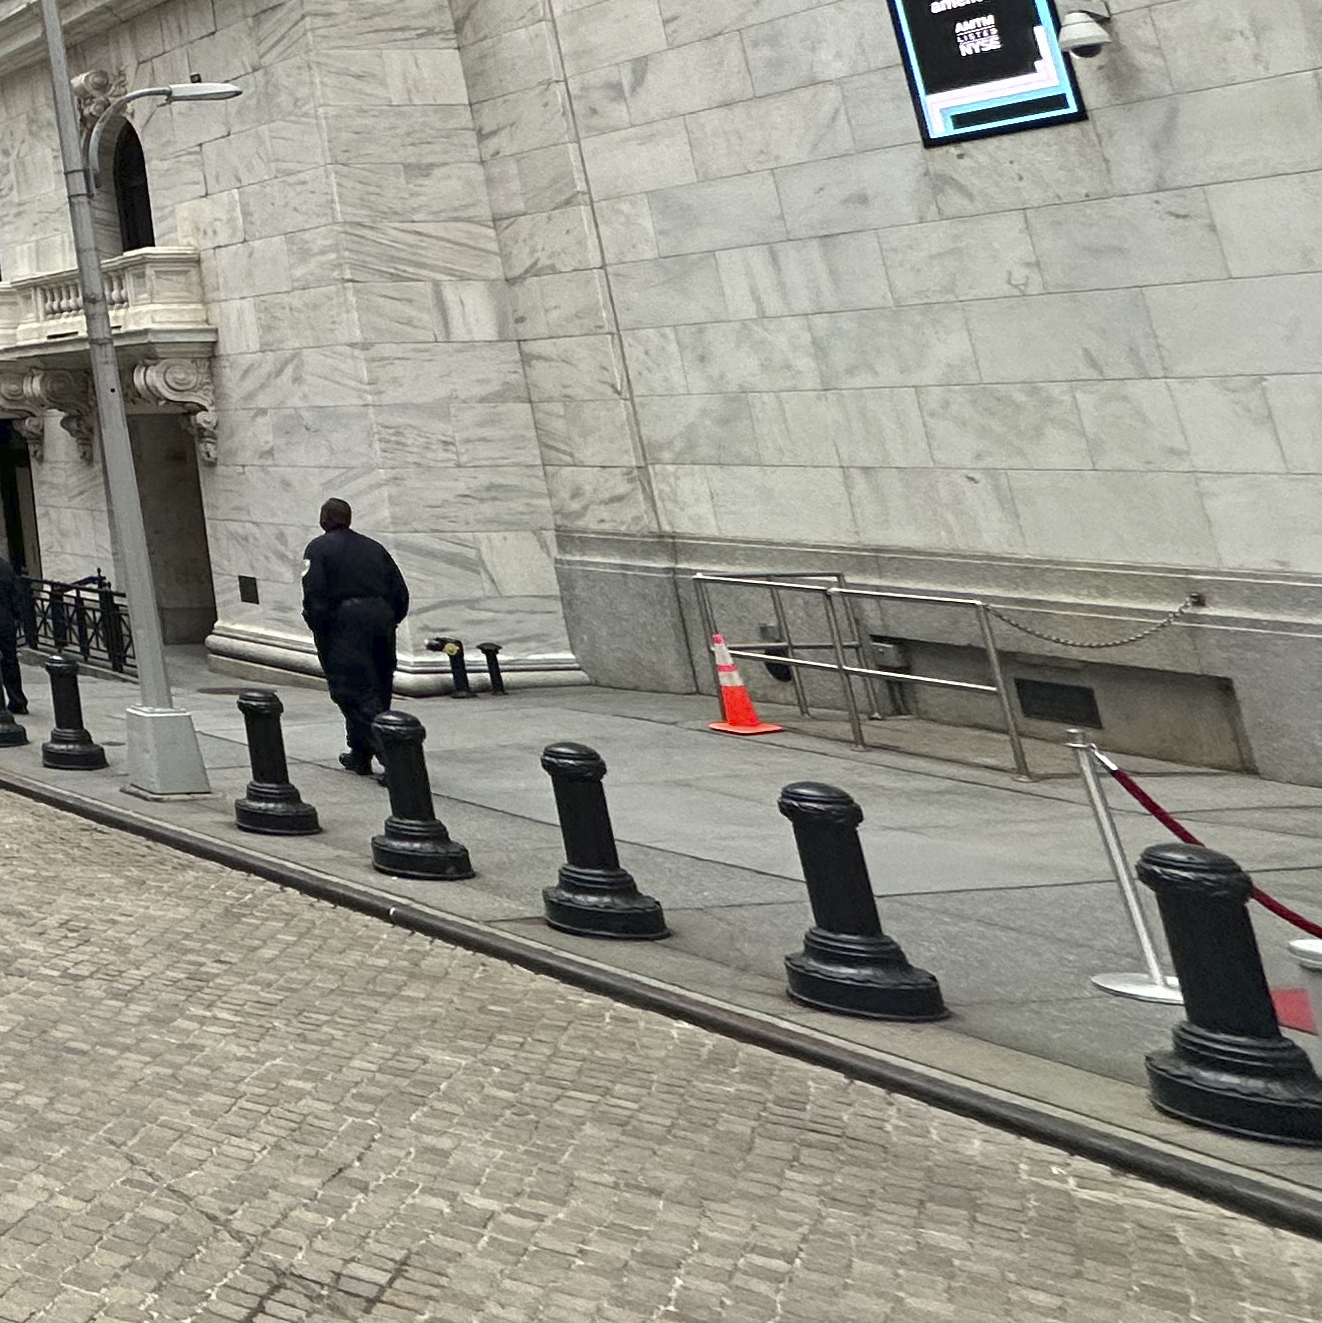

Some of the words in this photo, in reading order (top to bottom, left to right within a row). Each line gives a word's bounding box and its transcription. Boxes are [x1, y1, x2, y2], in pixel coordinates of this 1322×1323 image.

[955, 14, 995, 34] AMTM
[957, 28, 998, 42] LISTED
[959, 35, 1001, 57] NYSE
